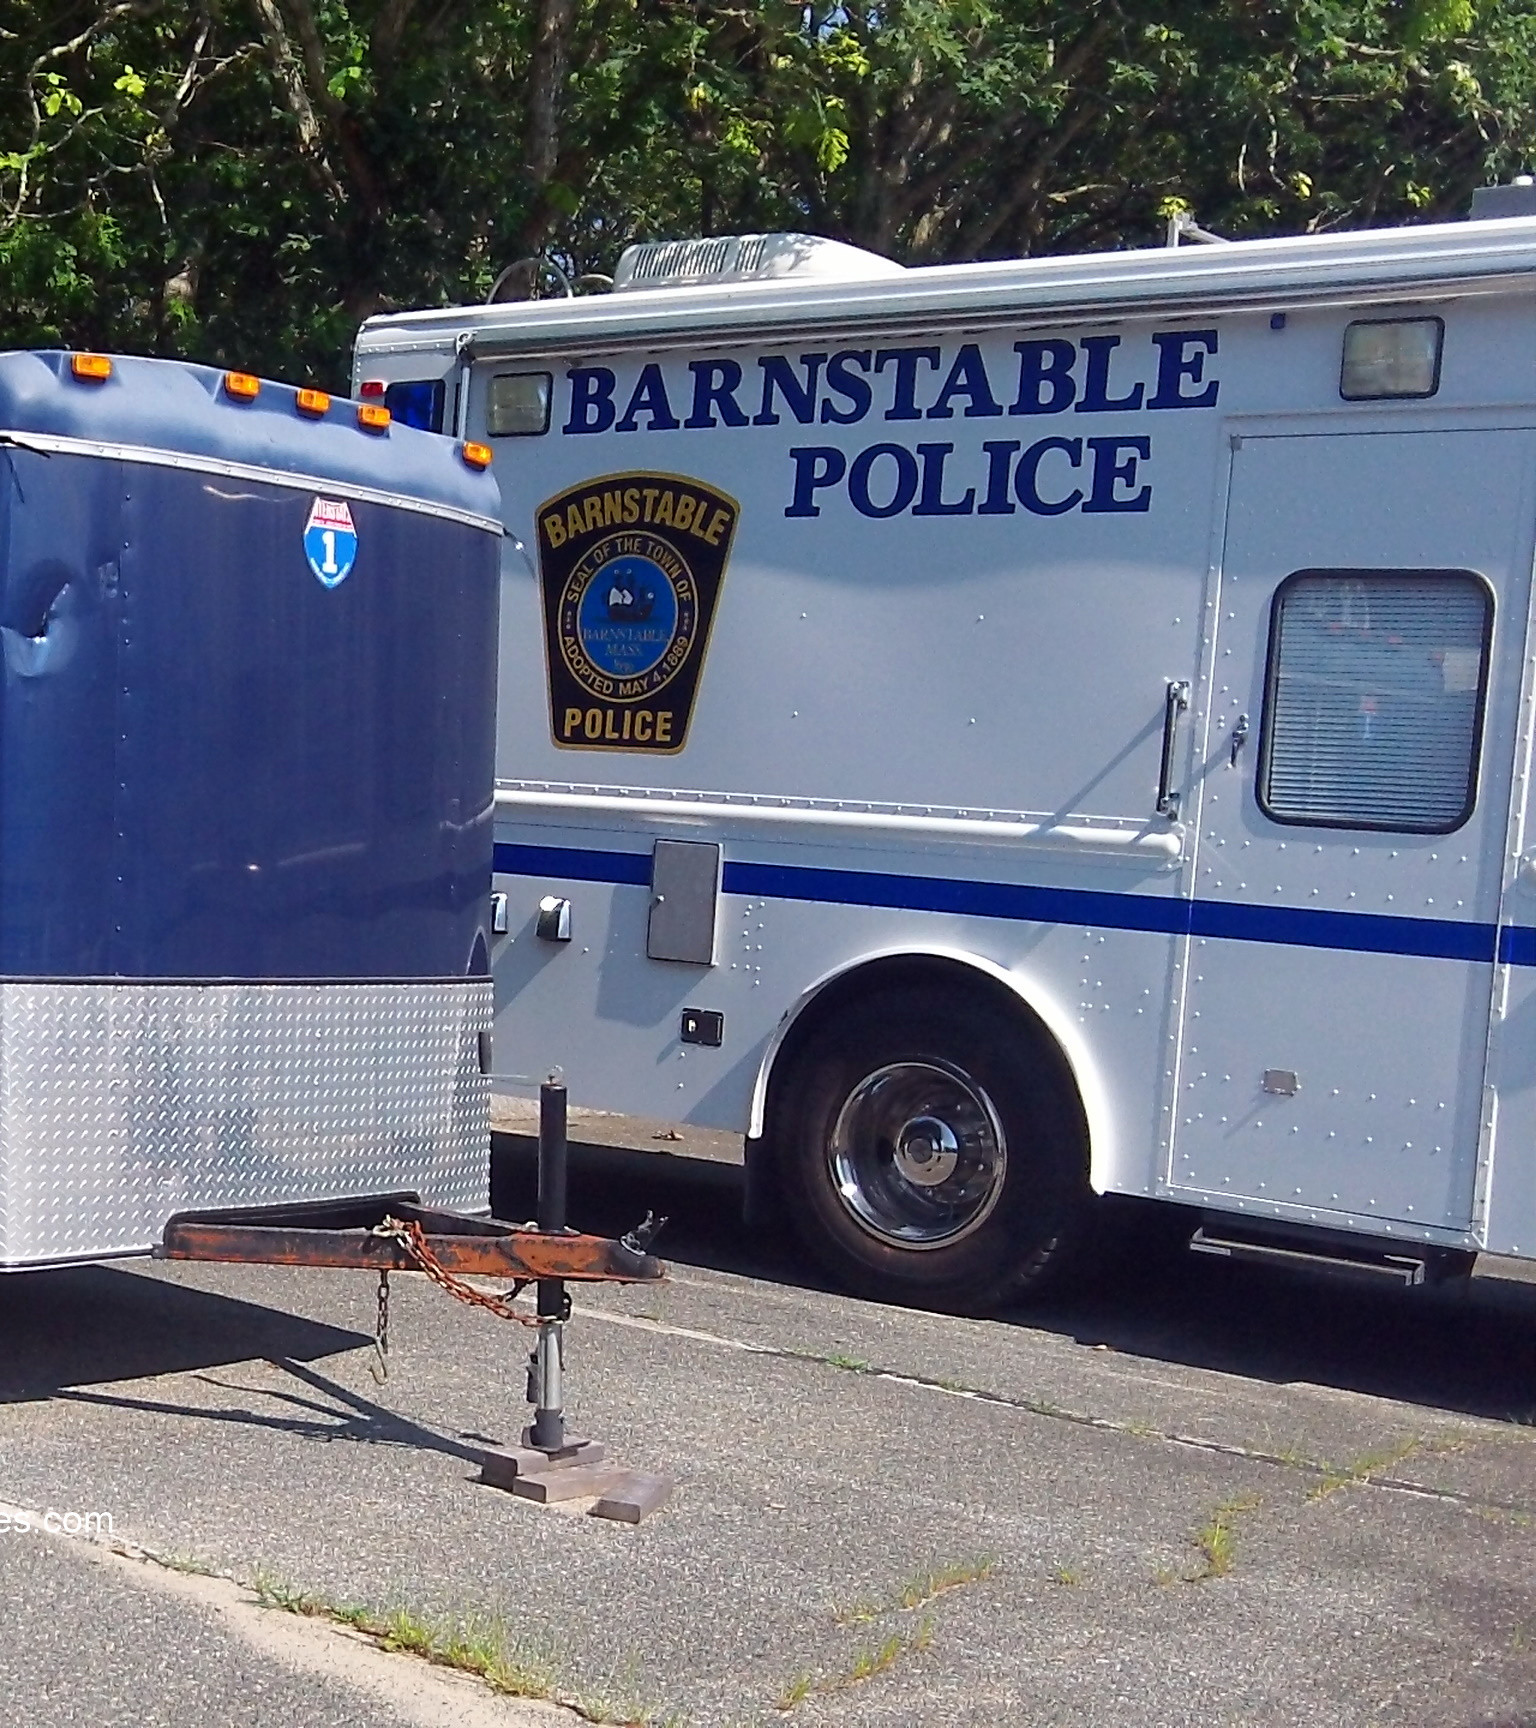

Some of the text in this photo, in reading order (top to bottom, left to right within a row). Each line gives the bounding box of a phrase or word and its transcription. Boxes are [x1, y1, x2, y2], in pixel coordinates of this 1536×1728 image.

[562, 329, 1220, 435] BARNSTABLE
[784, 436, 1153, 518] POLICE
[544, 488, 730, 549] BARNSTABLE
[322, 530, 338, 573] 1
[567, 537, 692, 603] SEAL OF THE TOWN OF
[564, 636, 614, 695] ADOPTED
[619, 677, 649, 696] MAY
[564, 708, 673, 742] POLICE
